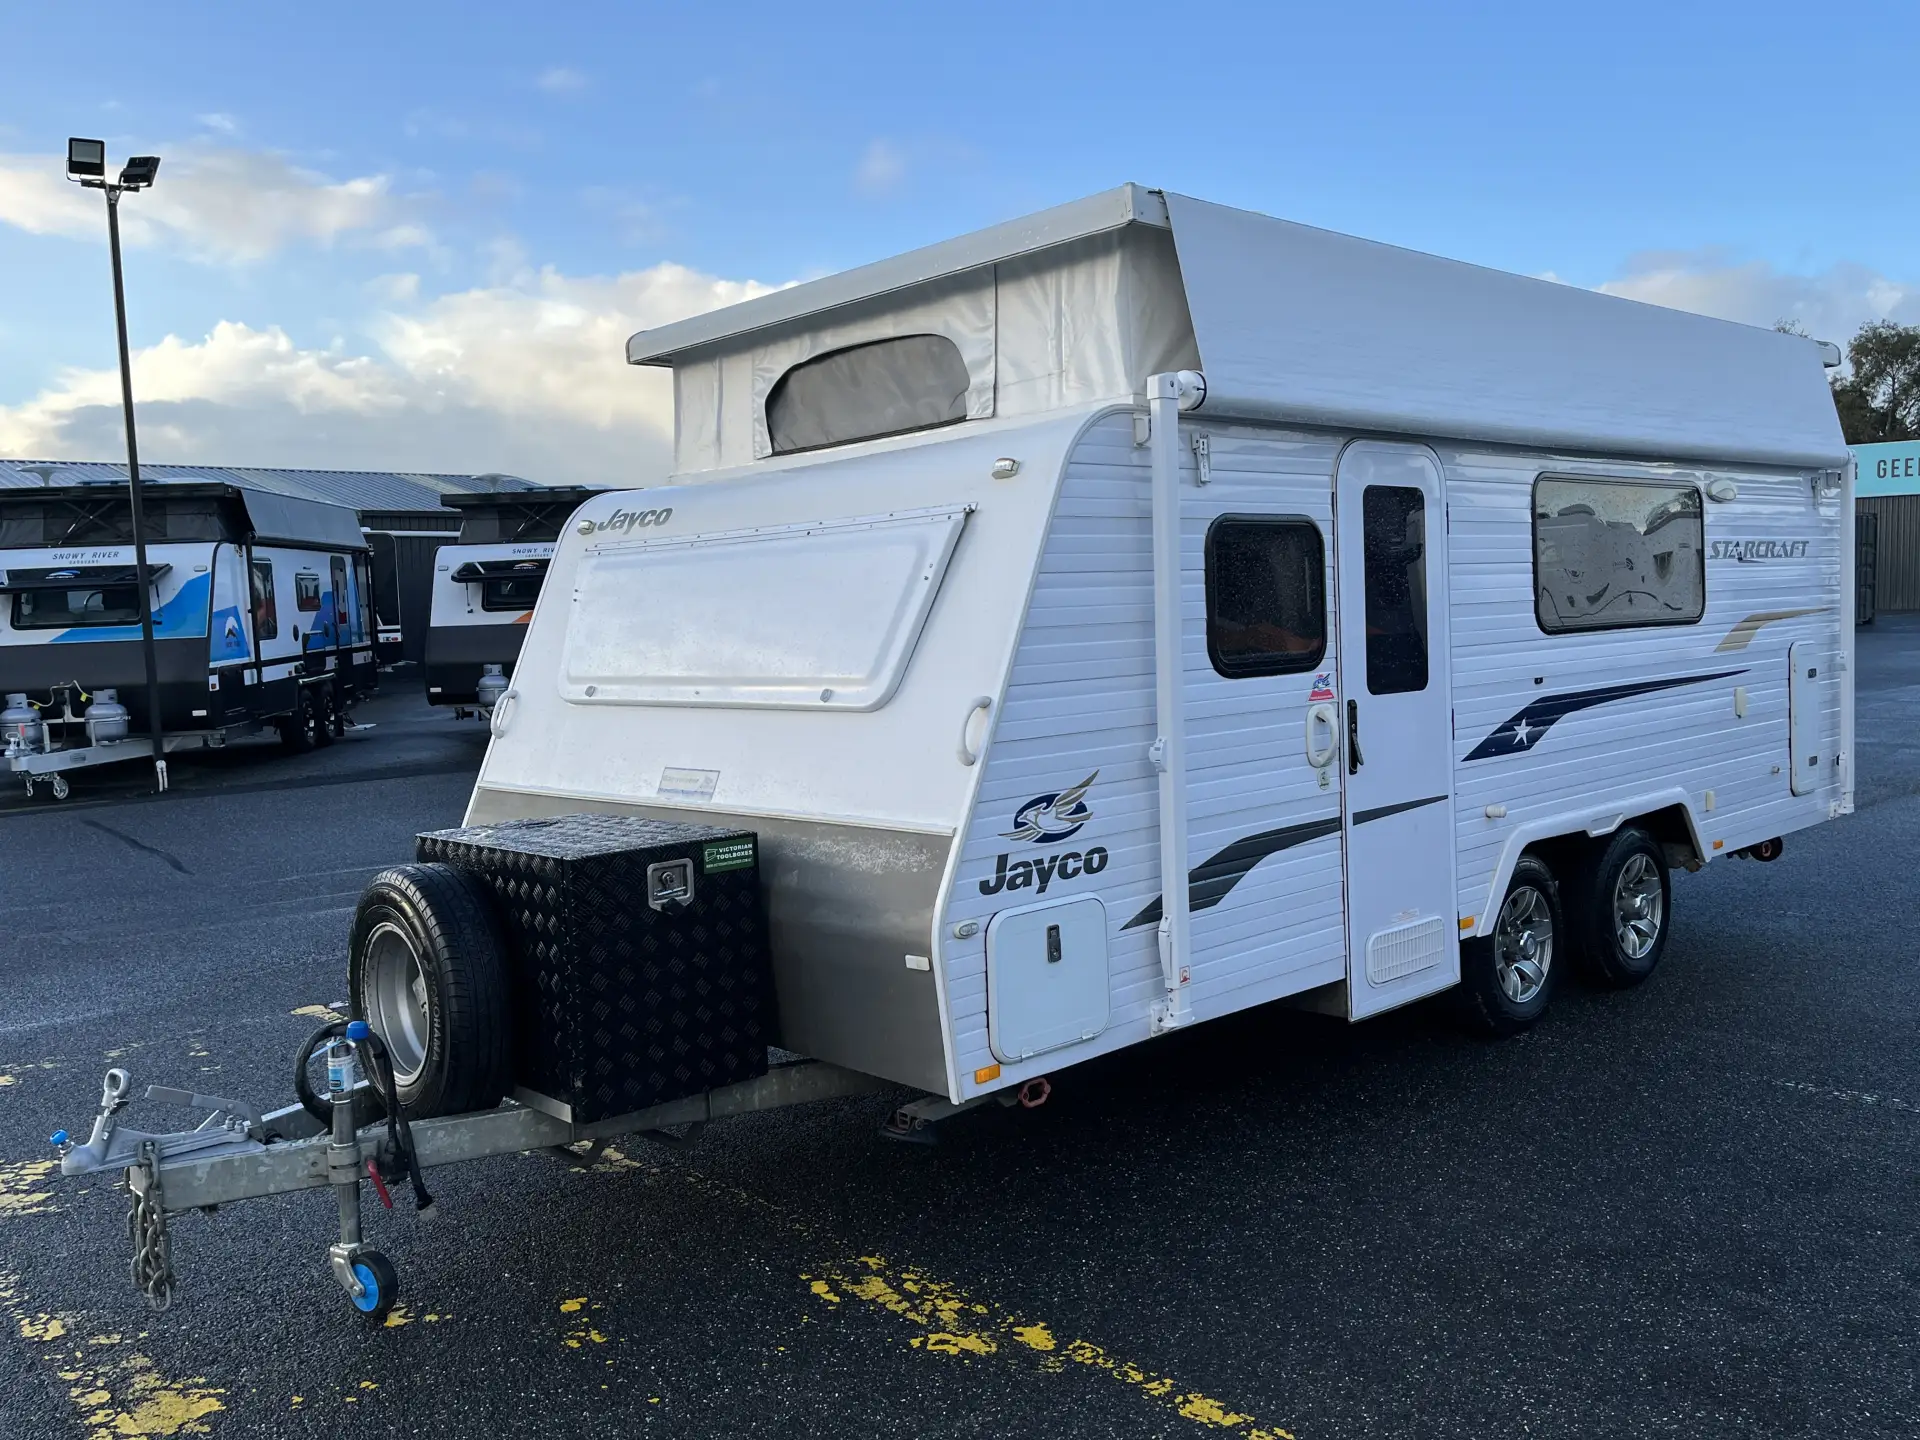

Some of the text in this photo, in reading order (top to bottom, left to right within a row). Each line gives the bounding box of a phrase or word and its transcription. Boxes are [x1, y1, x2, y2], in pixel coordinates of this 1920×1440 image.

[1876, 457, 1920, 479] GEE
[597, 508, 673, 535] Jayco
[1709, 540, 1809, 560] STARCRAFT
[716, 850, 753, 860] TOOLBOXES
[719, 843, 753, 853] VICTORIAN
[978, 846, 1109, 896] Jayco
[430, 975, 442, 1061] YOKOHAMA
